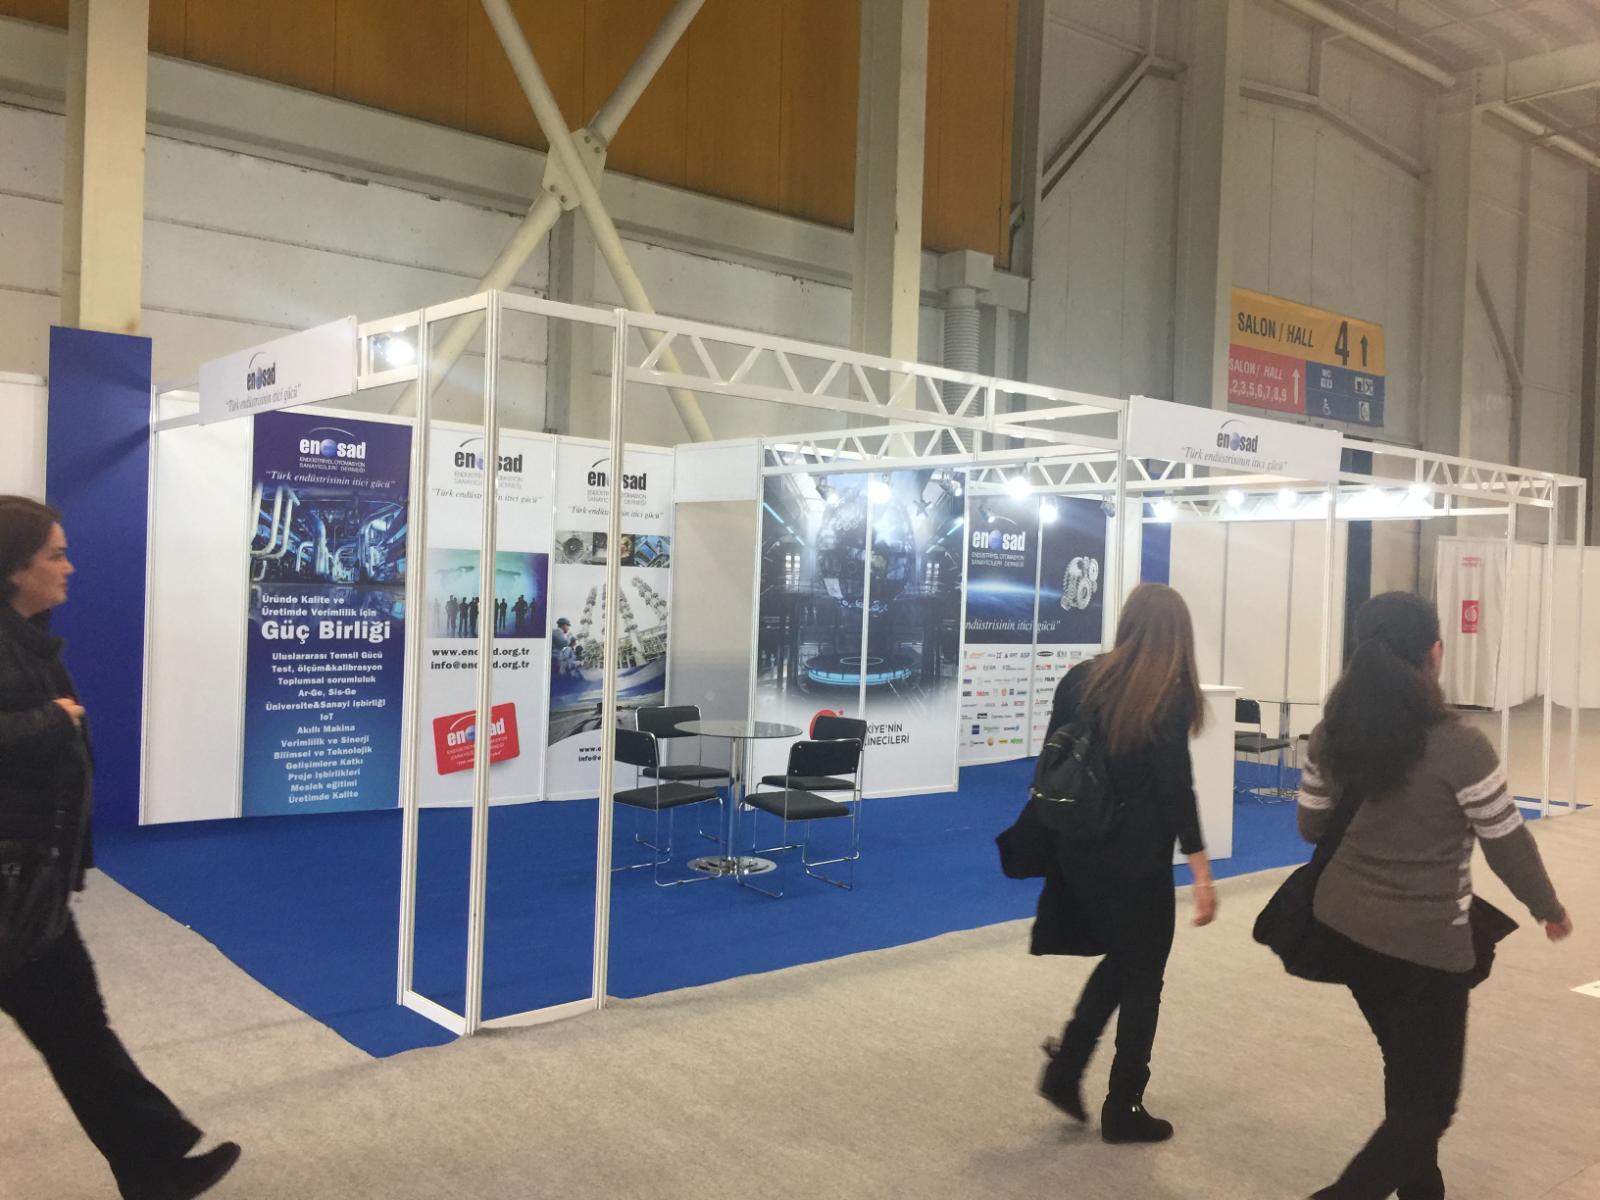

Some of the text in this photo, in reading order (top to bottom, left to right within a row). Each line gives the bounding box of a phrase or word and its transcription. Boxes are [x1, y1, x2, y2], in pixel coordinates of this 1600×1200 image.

[1238, 312, 1350, 366] SALON / HALL 4
[246, 362, 276, 391] enosad
[1264, 365, 1283, 380] HALL
[1217, 432, 1258, 453] enosad
[300, 439, 366, 460] enosad
[588, 471, 647, 490] ensad
[972, 530, 1026, 551] enosad
[262, 595, 298, 603] Üründe
[301, 596, 330, 604] Kalite
[262, 607, 308, 616] Üretimde
[311, 608, 357, 616] Verimlilik
[261, 620, 391, 644] Güç Birliği
[272, 652, 327, 660] Uluslararası
[361, 651, 383, 659] Gücü
[432, 648, 530, 657] www.enod.org.tr
[272, 665, 295, 673] Test,
[278, 675, 376, 685] Toplumsal sorumluluk
[298, 688, 356, 697] Ar-Ge, Sis-Ge
[266, 700, 350, 711] Üniversite&Sanayi
[320, 713, 333, 721] IoT
[323, 724, 355, 732] Makina
[341, 735, 369, 744] Sinerji
[274, 750, 311, 759] Bilimsel
[327, 746, 373, 756] Teknolojik
[288, 772, 312, 781] Proje
[291, 780, 357, 792] Meslek eğitimi
[288, 790, 359, 804] Üretimde Kalite
